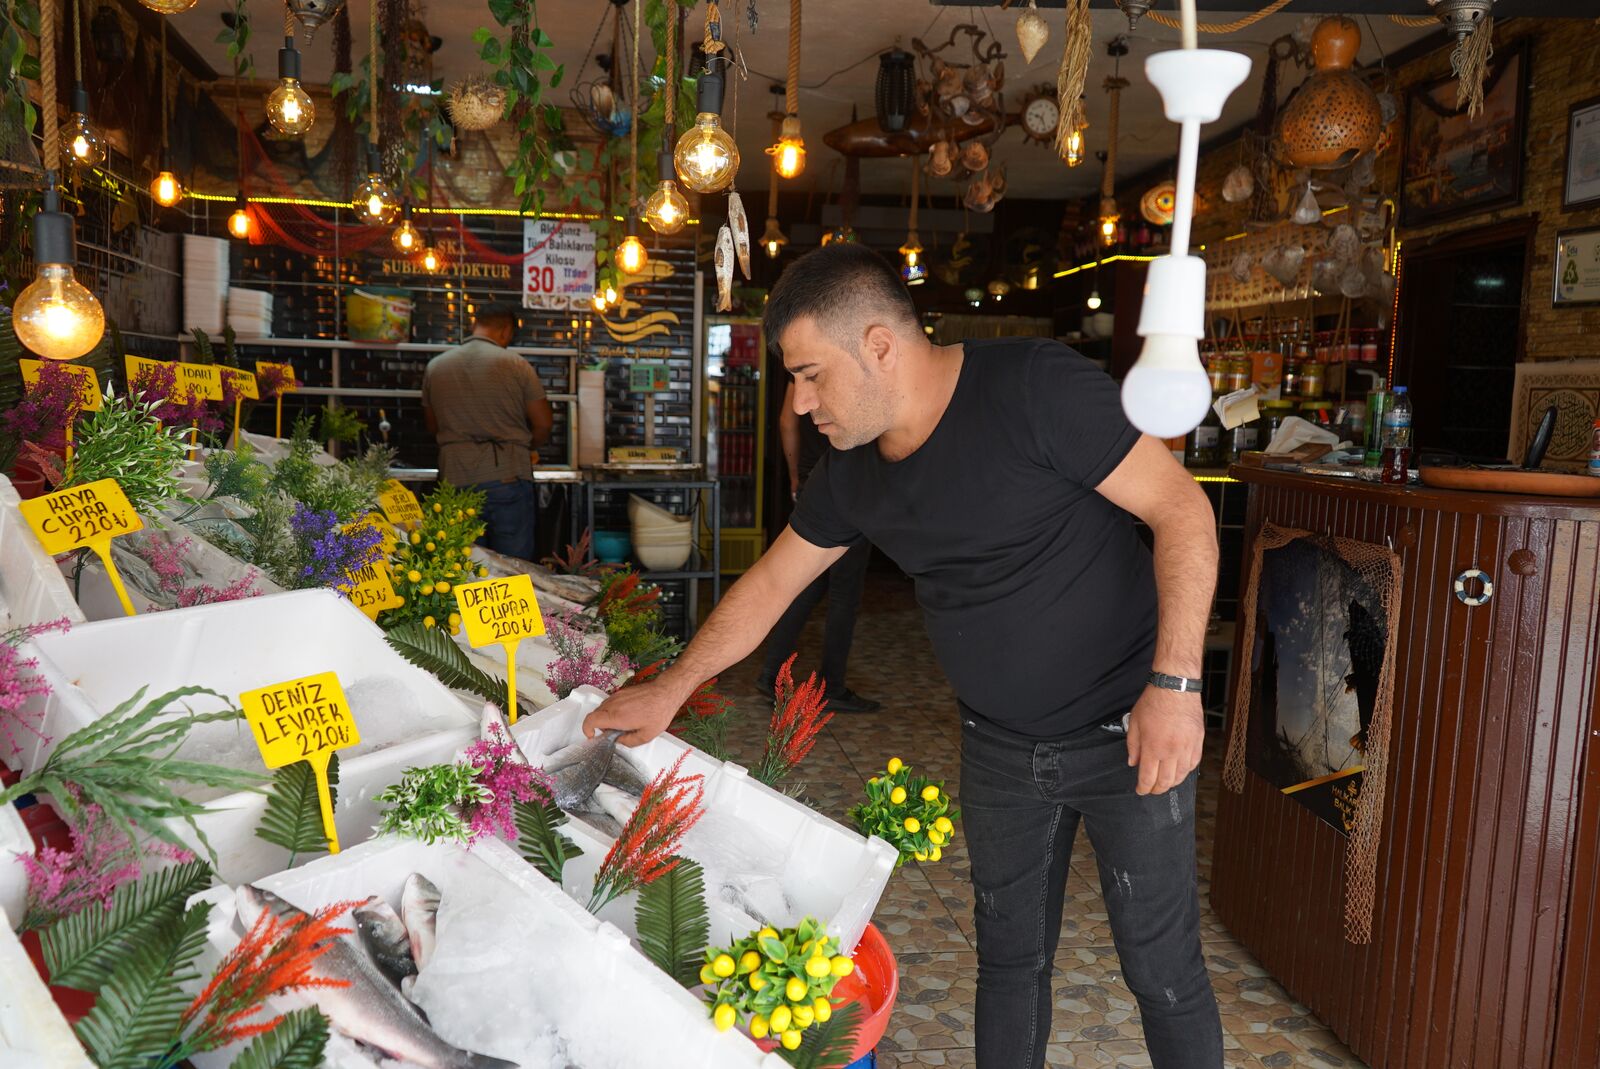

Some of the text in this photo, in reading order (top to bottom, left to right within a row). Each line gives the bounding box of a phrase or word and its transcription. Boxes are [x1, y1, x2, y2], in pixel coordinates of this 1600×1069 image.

[452, 261, 511, 279] YOKTUR
[545, 253, 576, 266] Kilosu
[527, 265, 555, 294] 30
[47, 488, 98, 515] KAYA
[42, 501, 109, 534] CUPRA
[462, 581, 514, 609] DENİZ
[478, 597, 531, 625] CUPRA
[260, 681, 328, 717] DENİZ
[258, 702, 345, 745] LEVREK
